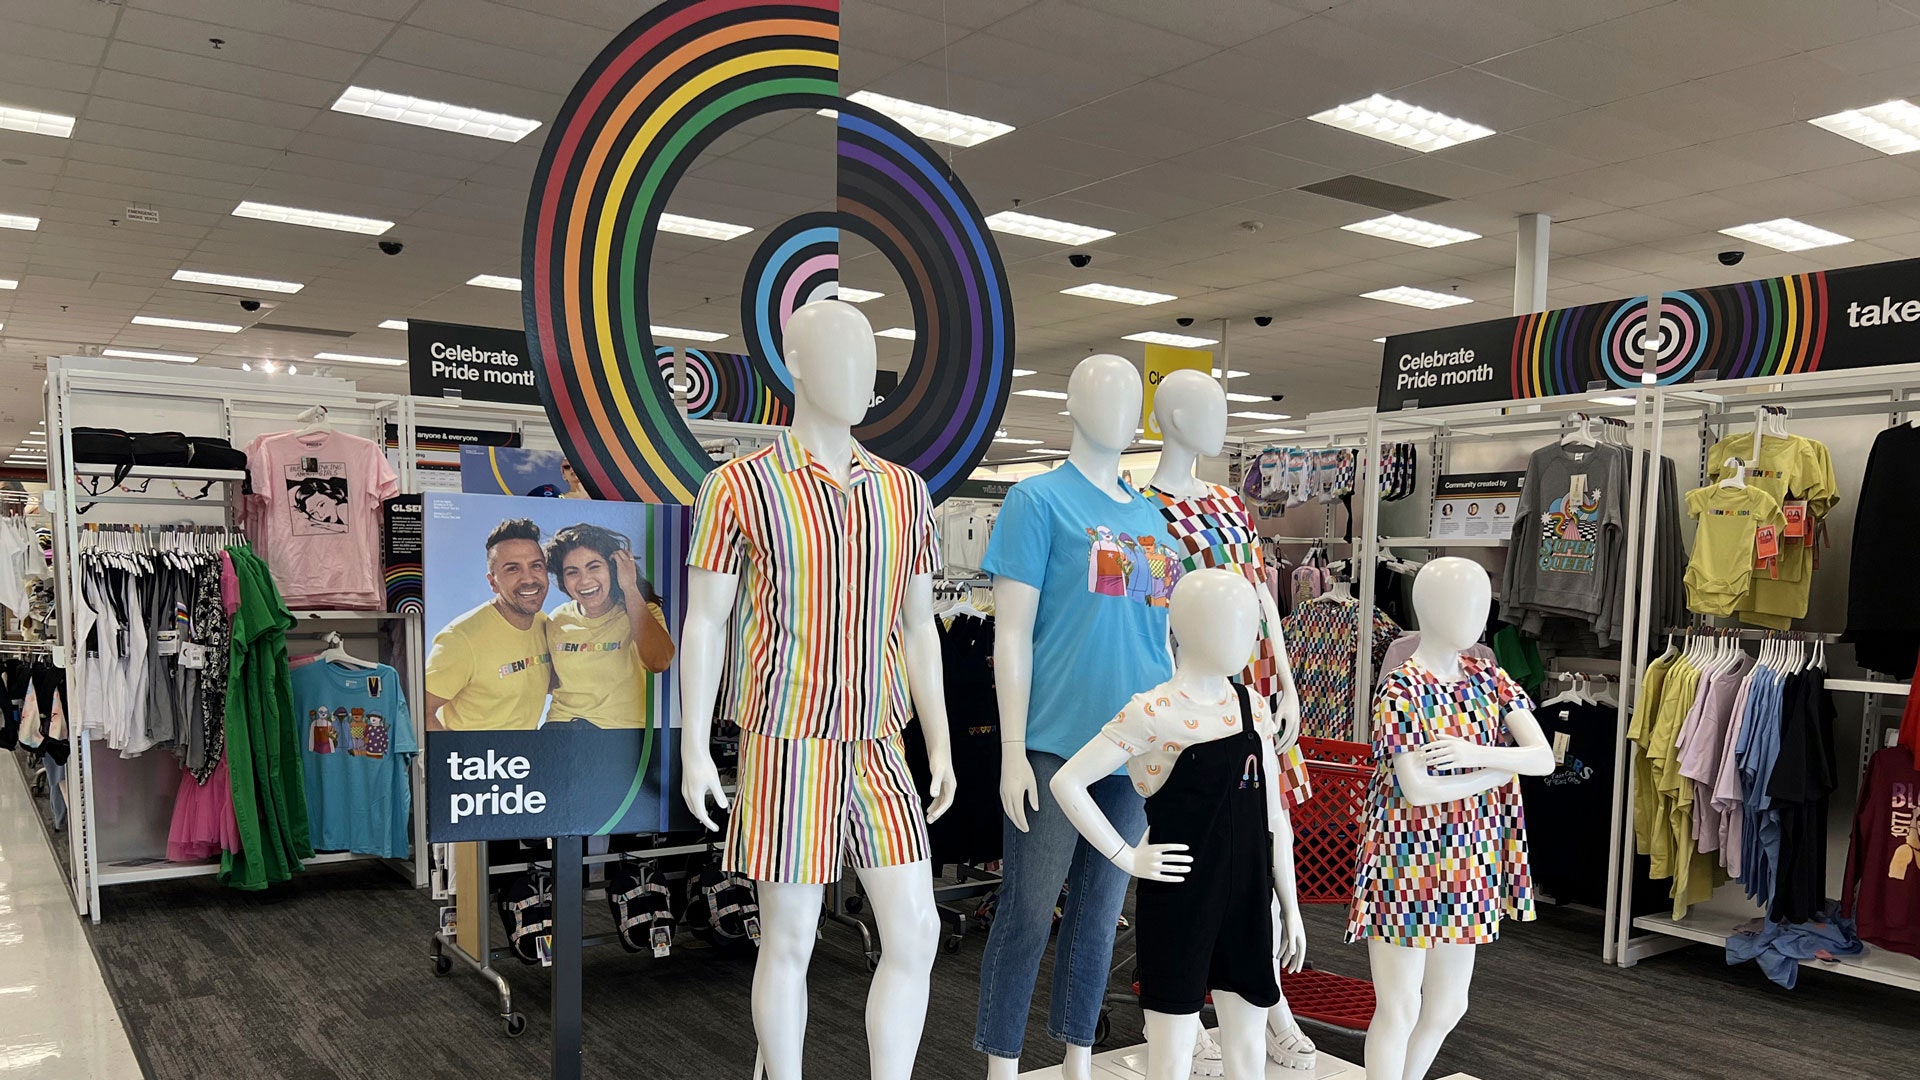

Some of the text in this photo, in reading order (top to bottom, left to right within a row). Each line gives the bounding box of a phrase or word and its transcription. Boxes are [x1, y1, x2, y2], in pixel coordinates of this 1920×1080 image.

[1847, 296, 1920, 328] take
[431, 342, 519, 366] Celebrate
[1399, 348, 1475, 371] Celebrate
[432, 361, 479, 381] Pride
[1397, 363, 1494, 391] Pride month
[448, 434, 479, 442] everyone
[1540, 540, 1596, 556] SUPER
[580, 640, 622, 652] PROUD!
[447, 749, 531, 780] take
[450, 784, 547, 823] pride
[1891, 811, 1912, 838] 1977
